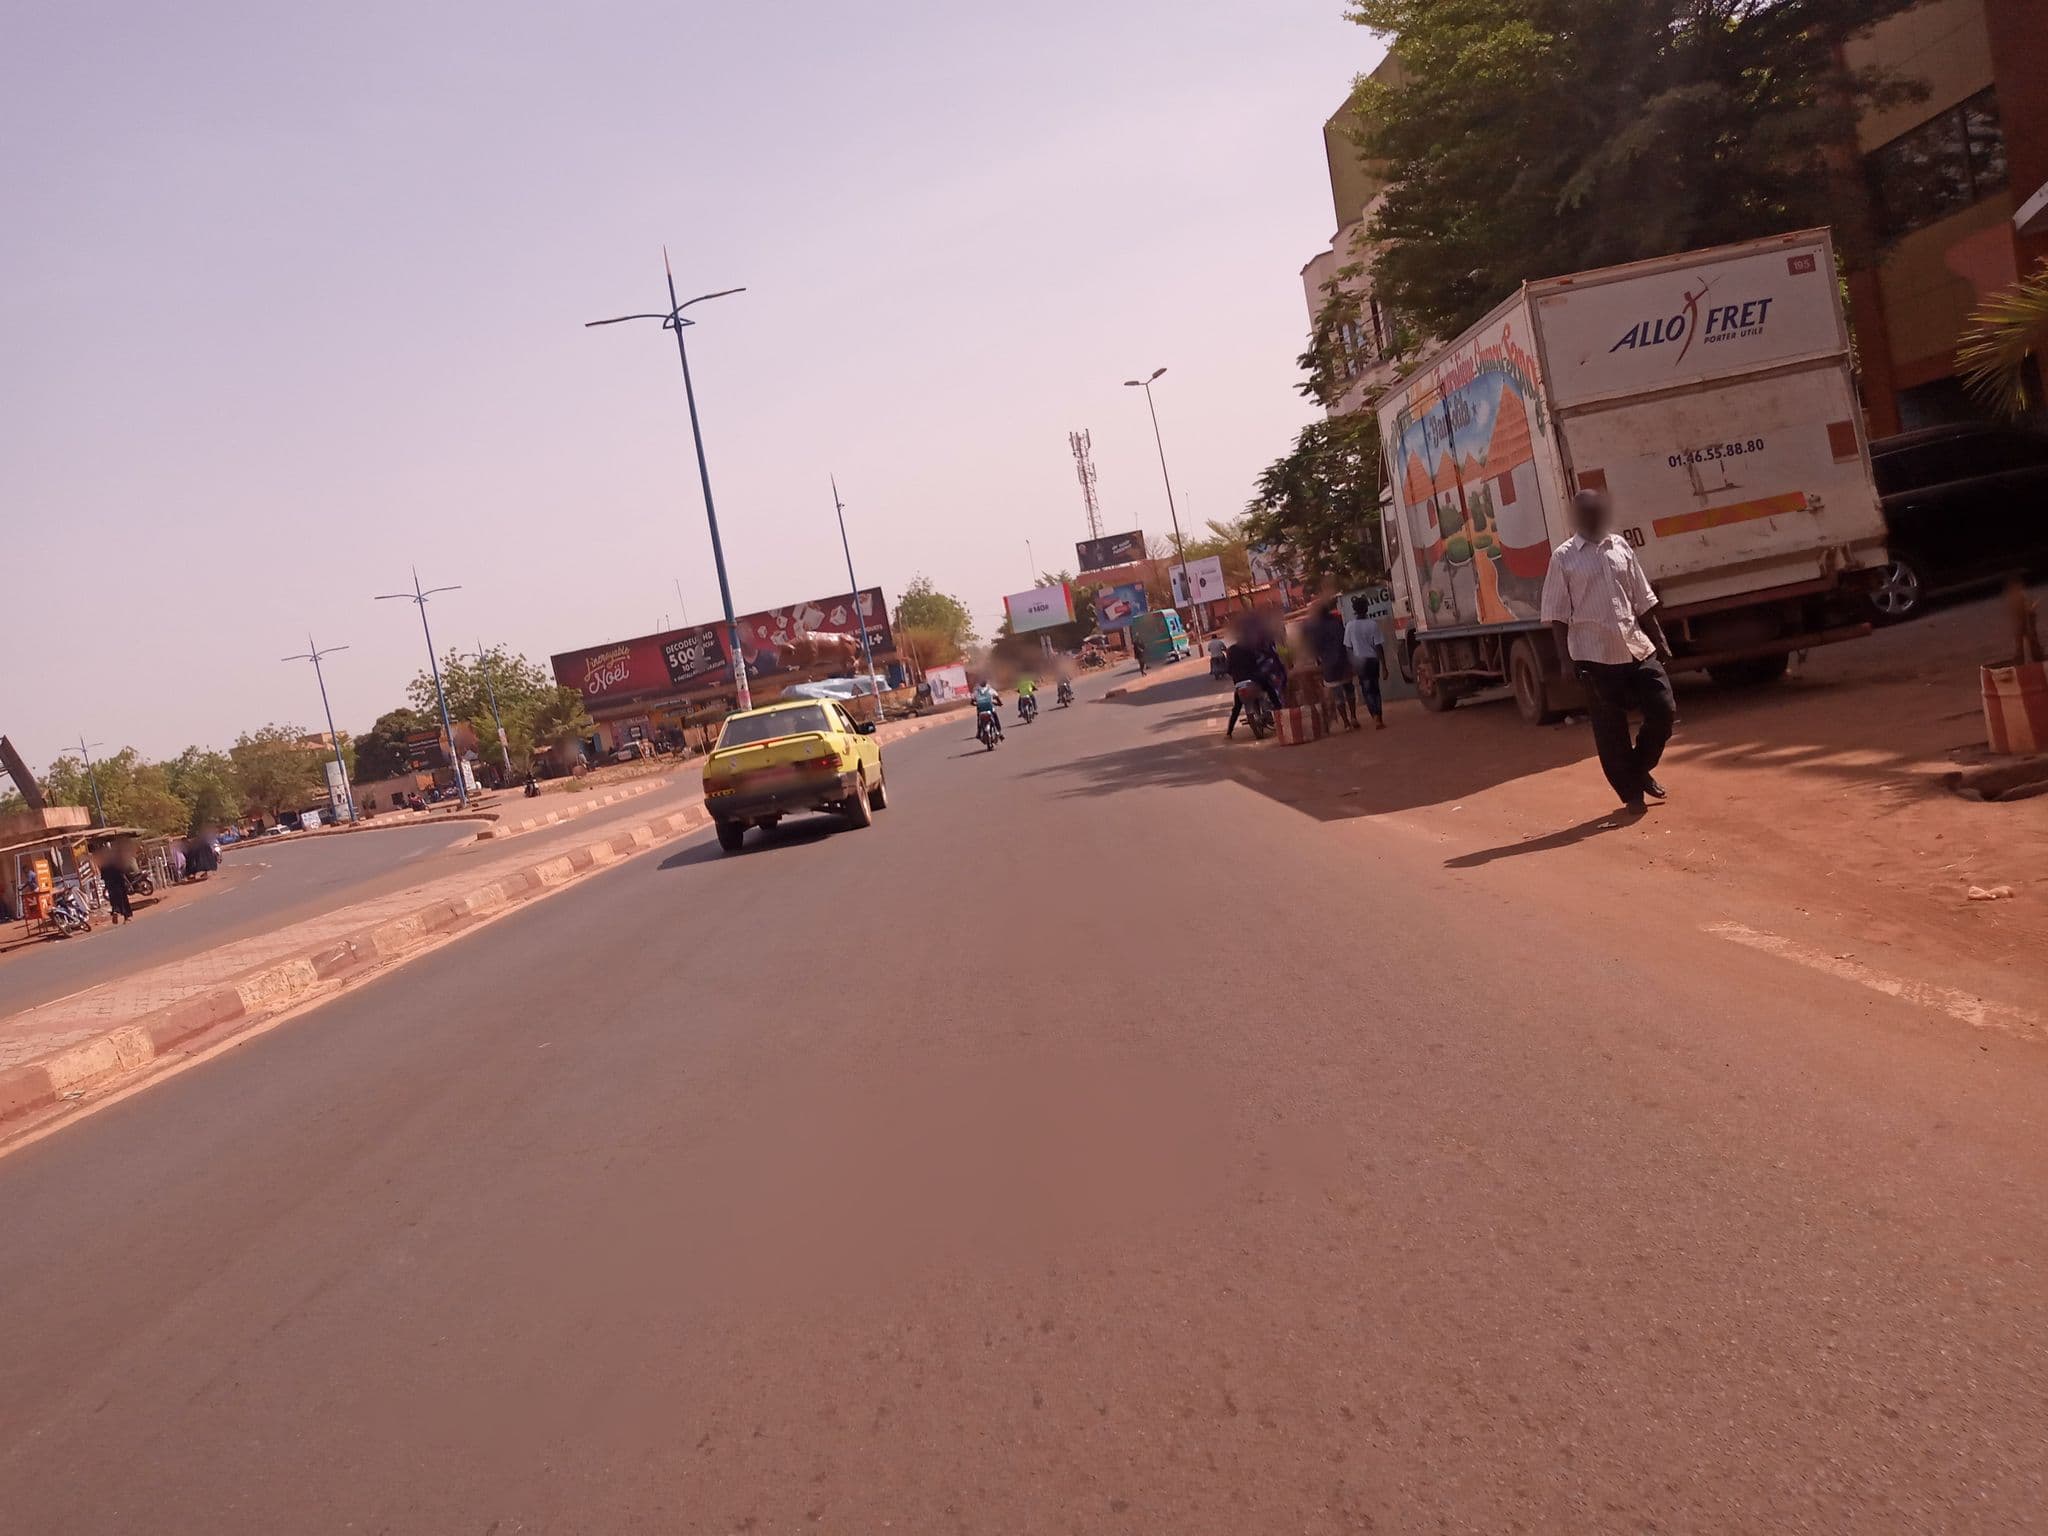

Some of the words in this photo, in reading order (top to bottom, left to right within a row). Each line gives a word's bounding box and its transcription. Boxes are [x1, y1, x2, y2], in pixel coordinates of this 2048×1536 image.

[1609, 315, 1685, 353] ALLO
[1705, 298, 1773, 335] FRET
[1704, 332, 1736, 344] PORTER
[1668, 438, 1764, 467] 01.46.55.88.80
[588, 660, 630, 694] Noël
